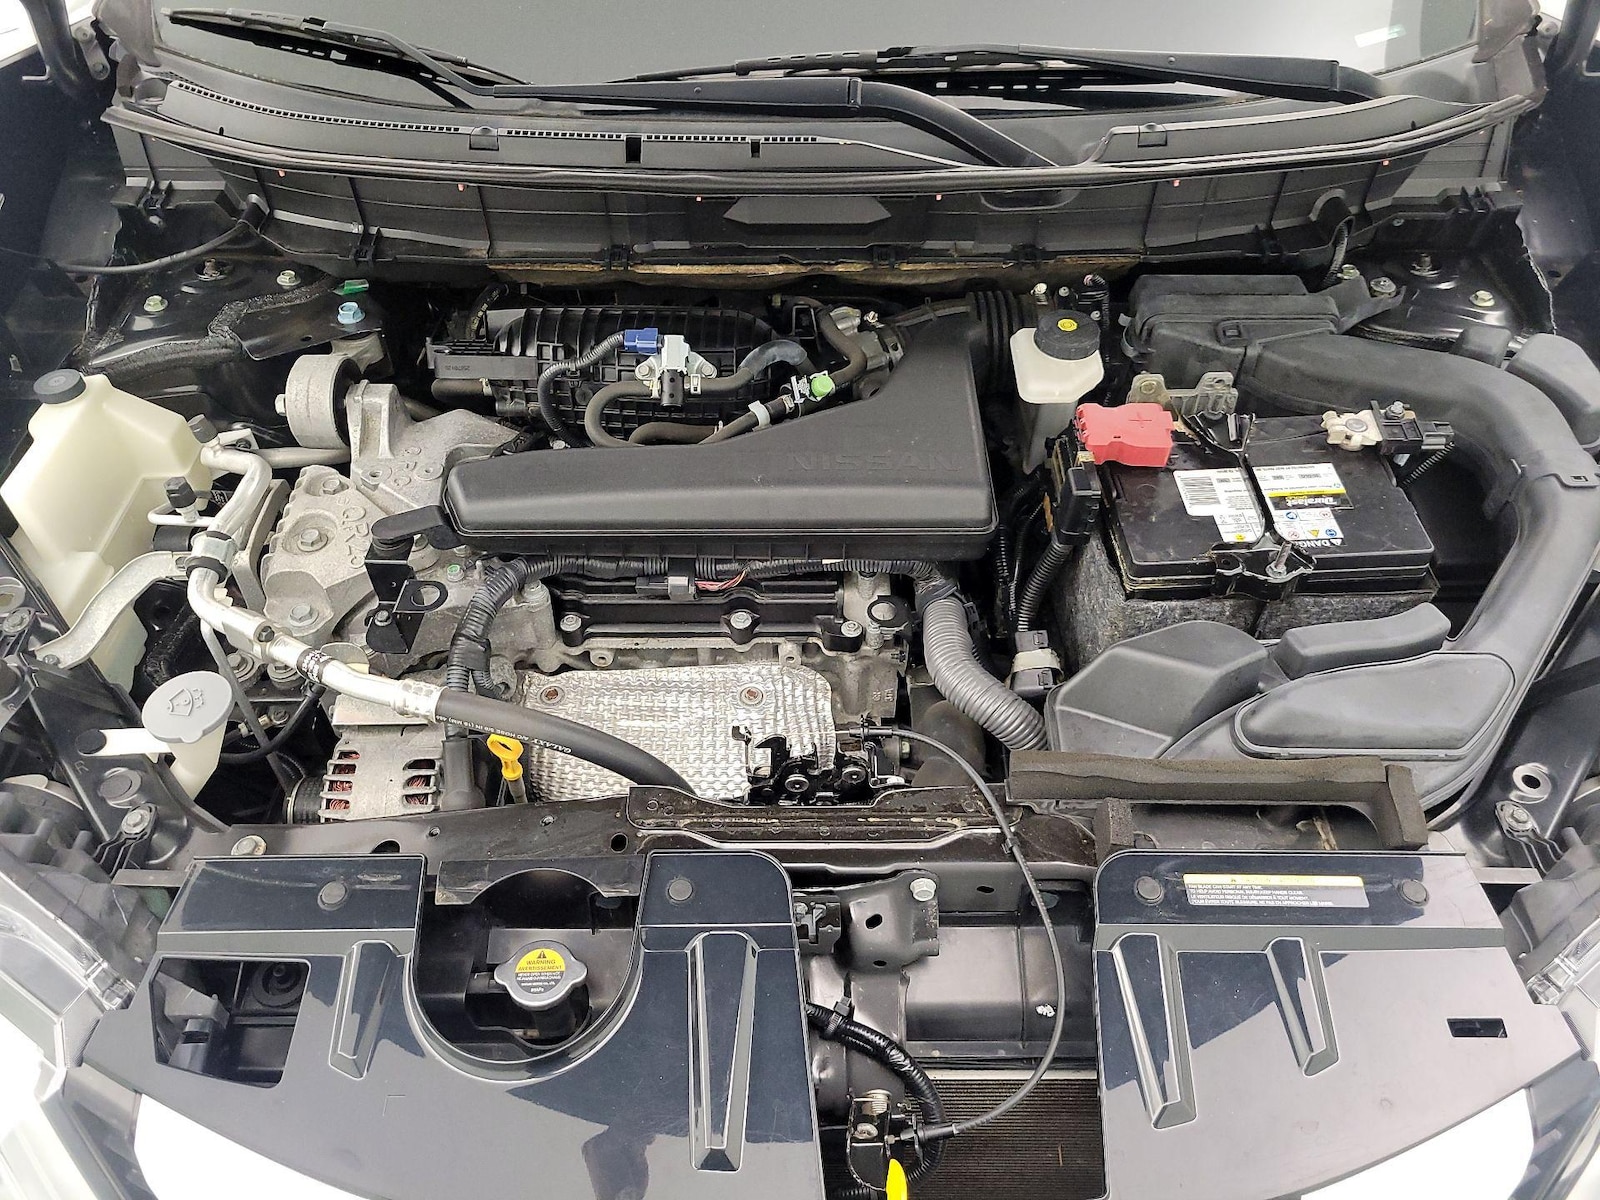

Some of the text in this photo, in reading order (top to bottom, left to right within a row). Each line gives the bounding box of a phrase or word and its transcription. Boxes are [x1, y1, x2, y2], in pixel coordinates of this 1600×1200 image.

[787, 453, 961, 472] NISSAN
[1285, 497, 1338, 507] Duralast
[1293, 539, 1331, 549] DANG
[495, 728, 516, 738] HOSE
[516, 734, 529, 742] A/C
[530, 737, 572, 754] GALAXY
